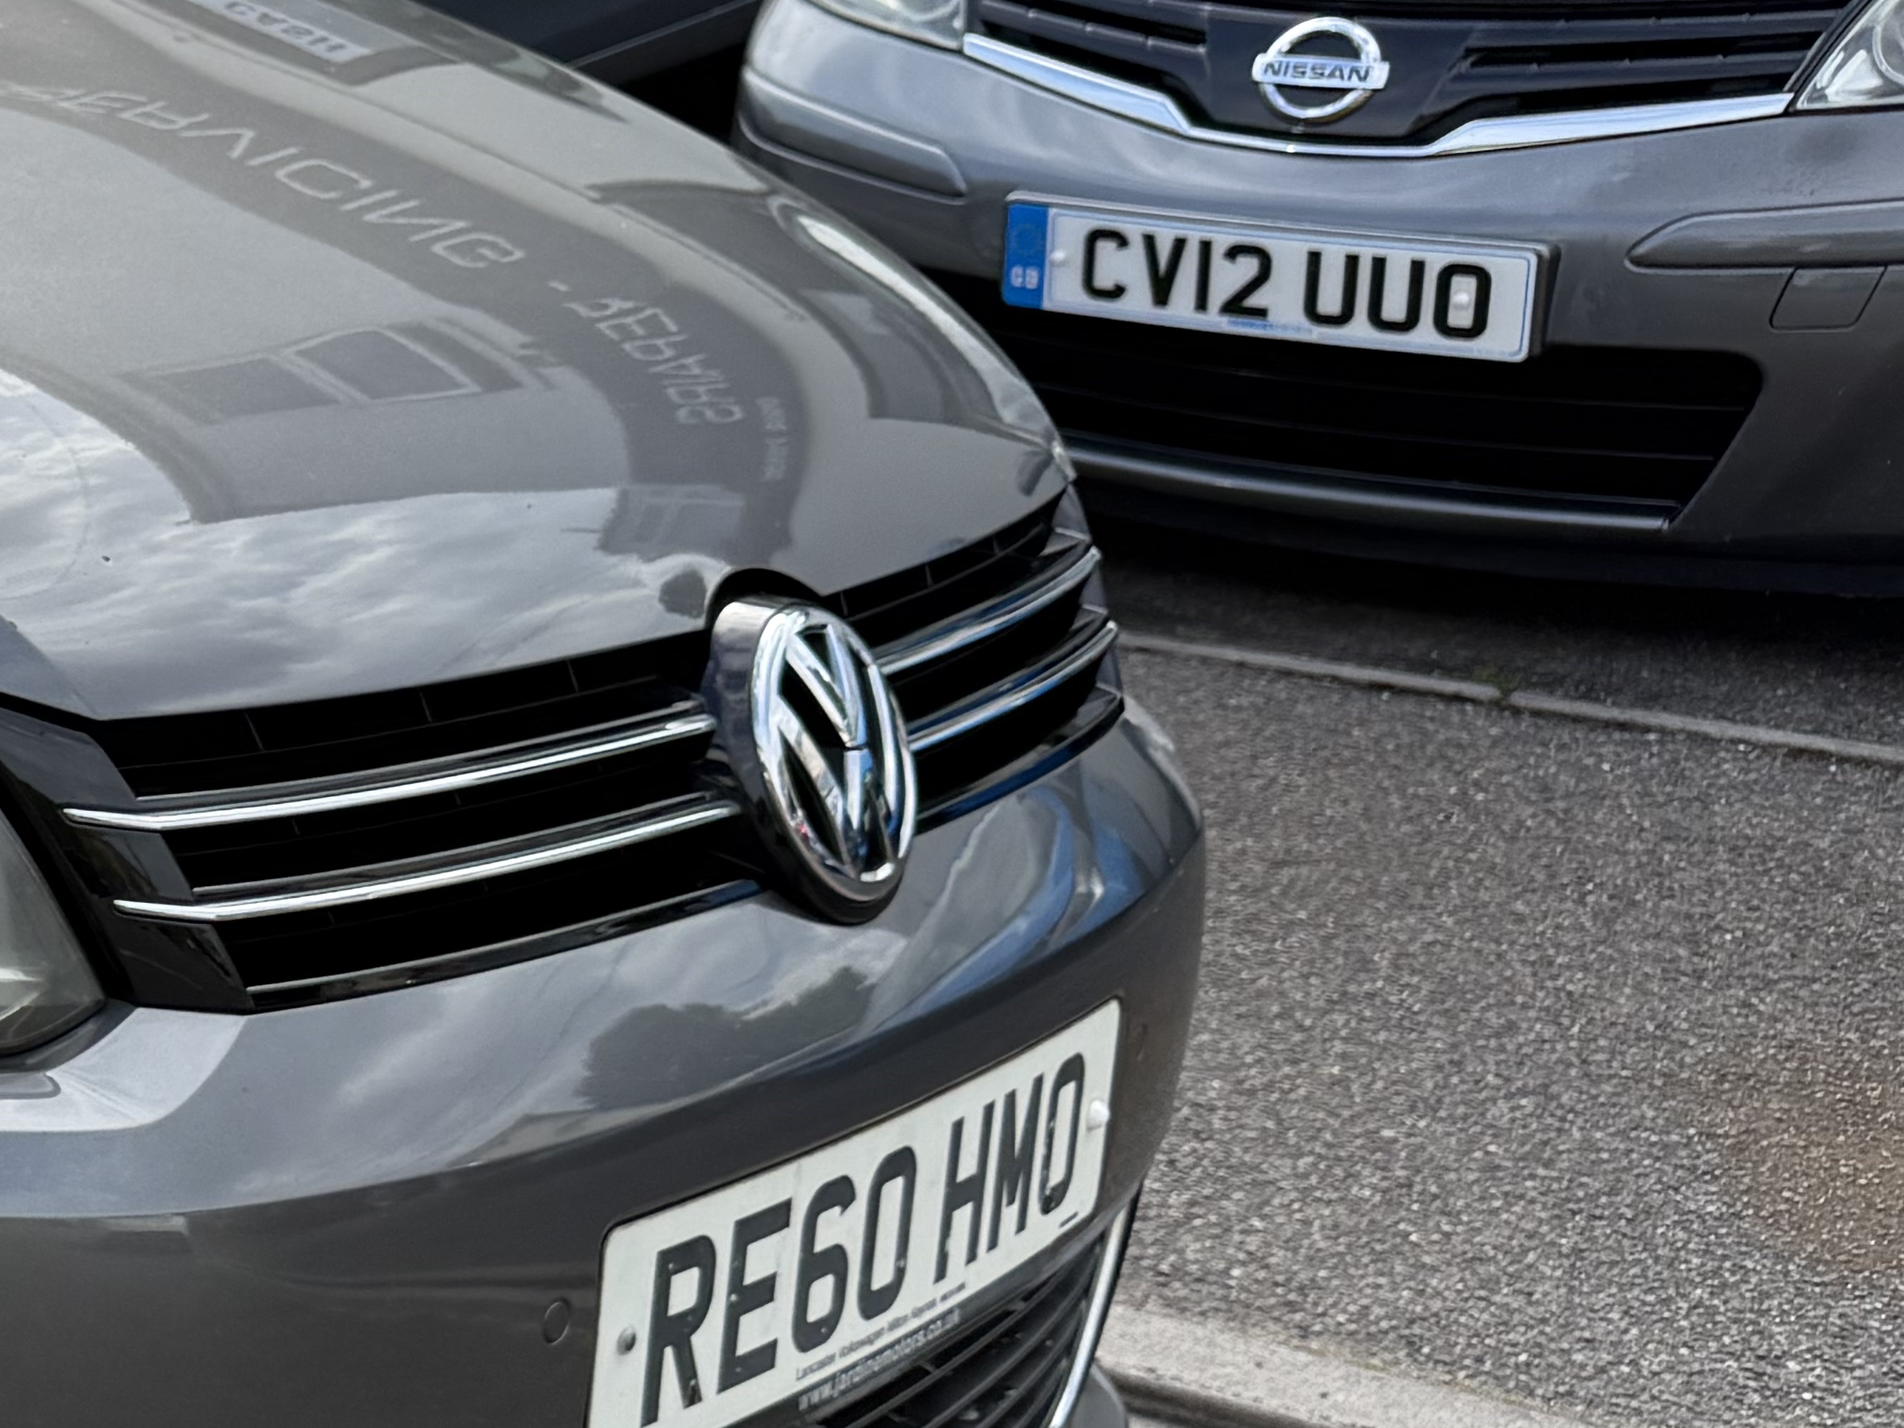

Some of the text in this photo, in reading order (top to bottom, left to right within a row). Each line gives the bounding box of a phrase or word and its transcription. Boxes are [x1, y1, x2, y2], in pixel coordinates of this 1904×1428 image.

[1263, 60, 1370, 83] NISSAN
[1081, 228, 1493, 340] CV12 UUO
[640, 1052, 1086, 1428] RE60 HMO
